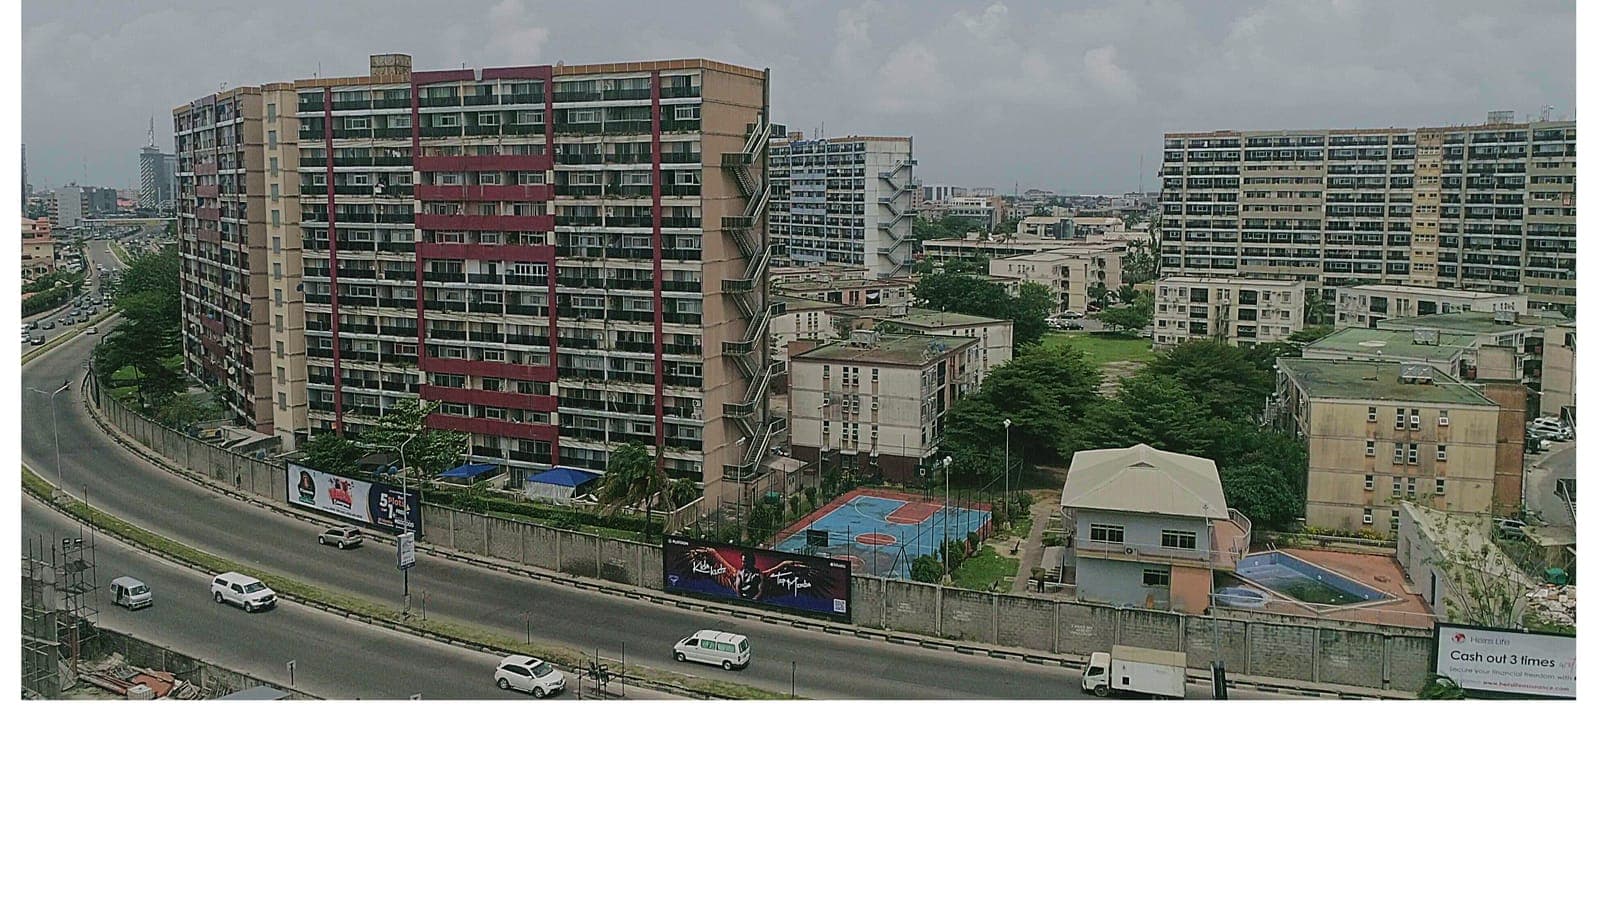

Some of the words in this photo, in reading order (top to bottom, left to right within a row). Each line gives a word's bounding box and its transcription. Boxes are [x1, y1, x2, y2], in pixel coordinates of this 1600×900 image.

[379, 492, 388, 508] 5
[1495, 637, 1510, 647] Life
[1450, 650, 1482, 663] Cash
[1486, 654, 1506, 664] out
[1510, 655, 1517, 665] 3
[1521, 655, 1555, 668] times
[1449, 666, 1473, 674] Secure
[1474, 667, 1490, 676] your
[1492, 668, 1523, 677] financial
[1524, 671, 1555, 680] freedom
